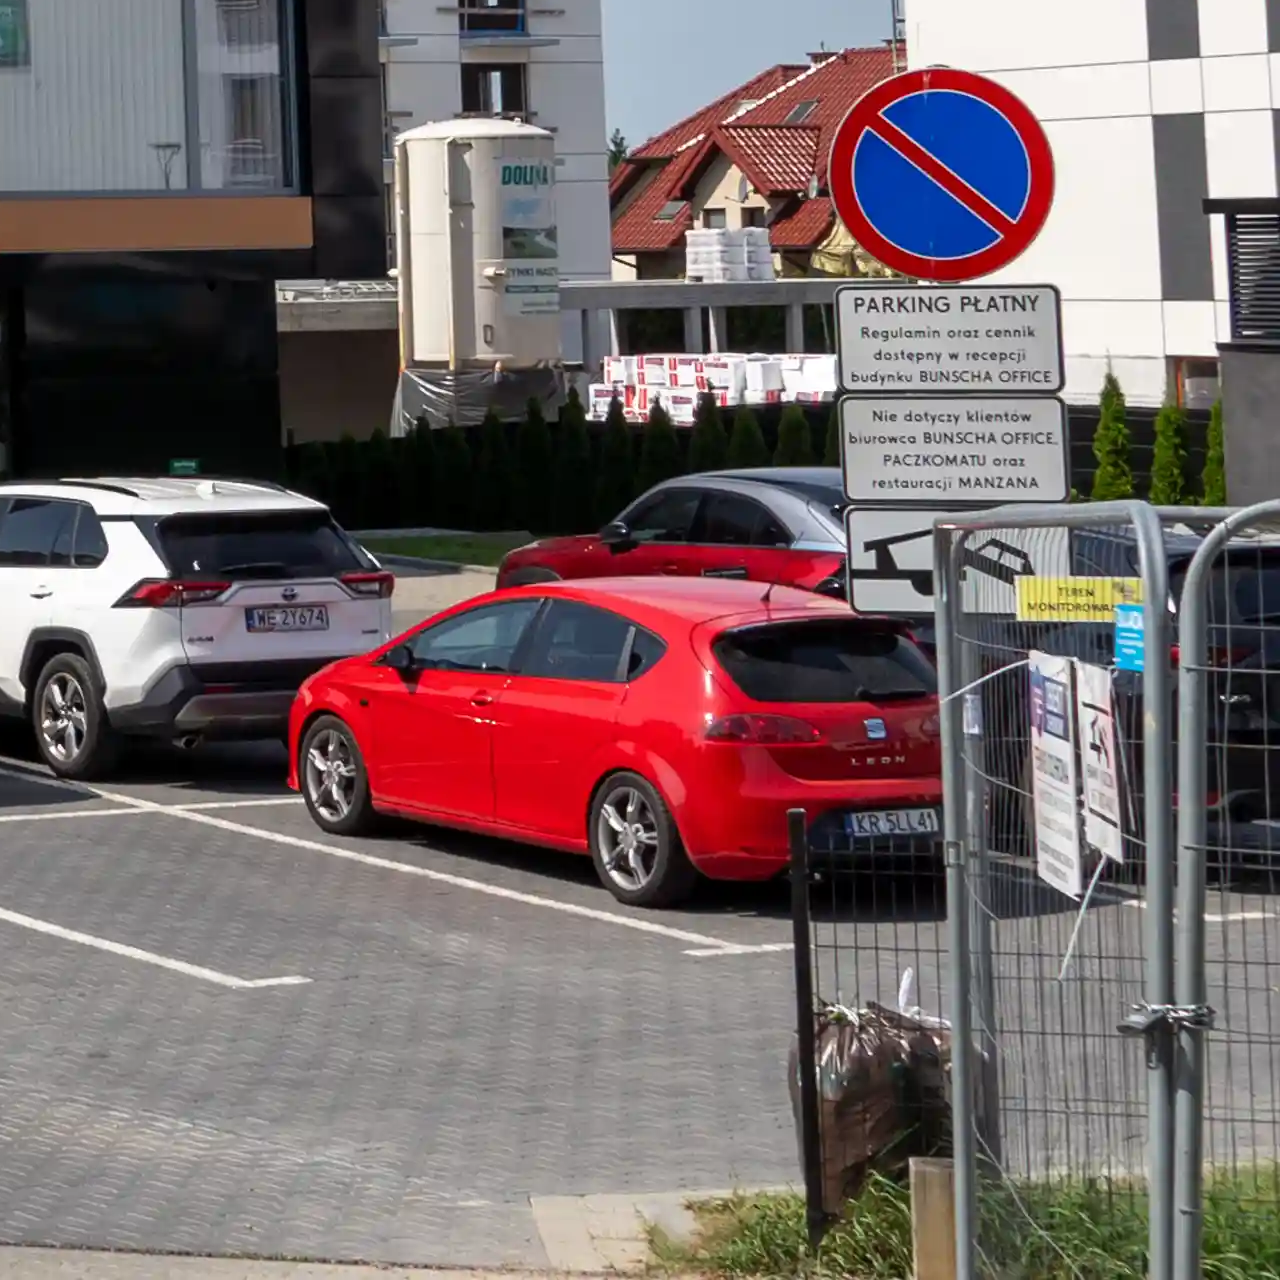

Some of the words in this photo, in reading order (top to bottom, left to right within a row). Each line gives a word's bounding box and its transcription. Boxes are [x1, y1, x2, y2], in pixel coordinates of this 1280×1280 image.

[853, 296, 951, 313] PARKING
[960, 295, 1040, 313] PŁATNY
[861, 326, 941, 342] Regulamin
[947, 329, 980, 339] oraz
[985, 326, 1036, 339] cennik
[873, 349, 942, 365] dostępny
[949, 352, 960, 361] w
[965, 349, 1027, 364] recepcji
[851, 371, 913, 387] budynku
[919, 370, 993, 383] BUNSCHA
[998, 370, 1053, 383] OFFICE
[872, 410, 897, 423] Nie
[904, 410, 960, 426] dotyczy
[966, 410, 1032, 423] klientów
[849, 432, 917, 445] biurowca
[923, 432, 997, 445] BUNSCHA
[883, 455, 986, 467] PACZKOMATU
[992, 457, 1026, 467] oraz
[872, 476, 953, 492] restauracji
[958, 477, 1040, 489] MANZANA
[256, 610, 277, 626] WE
[281, 608, 325, 626] 2Y674
[851, 755, 906, 766] LEON
[856, 814, 881, 834] KR
[885, 811, 936, 832] 5LL41
